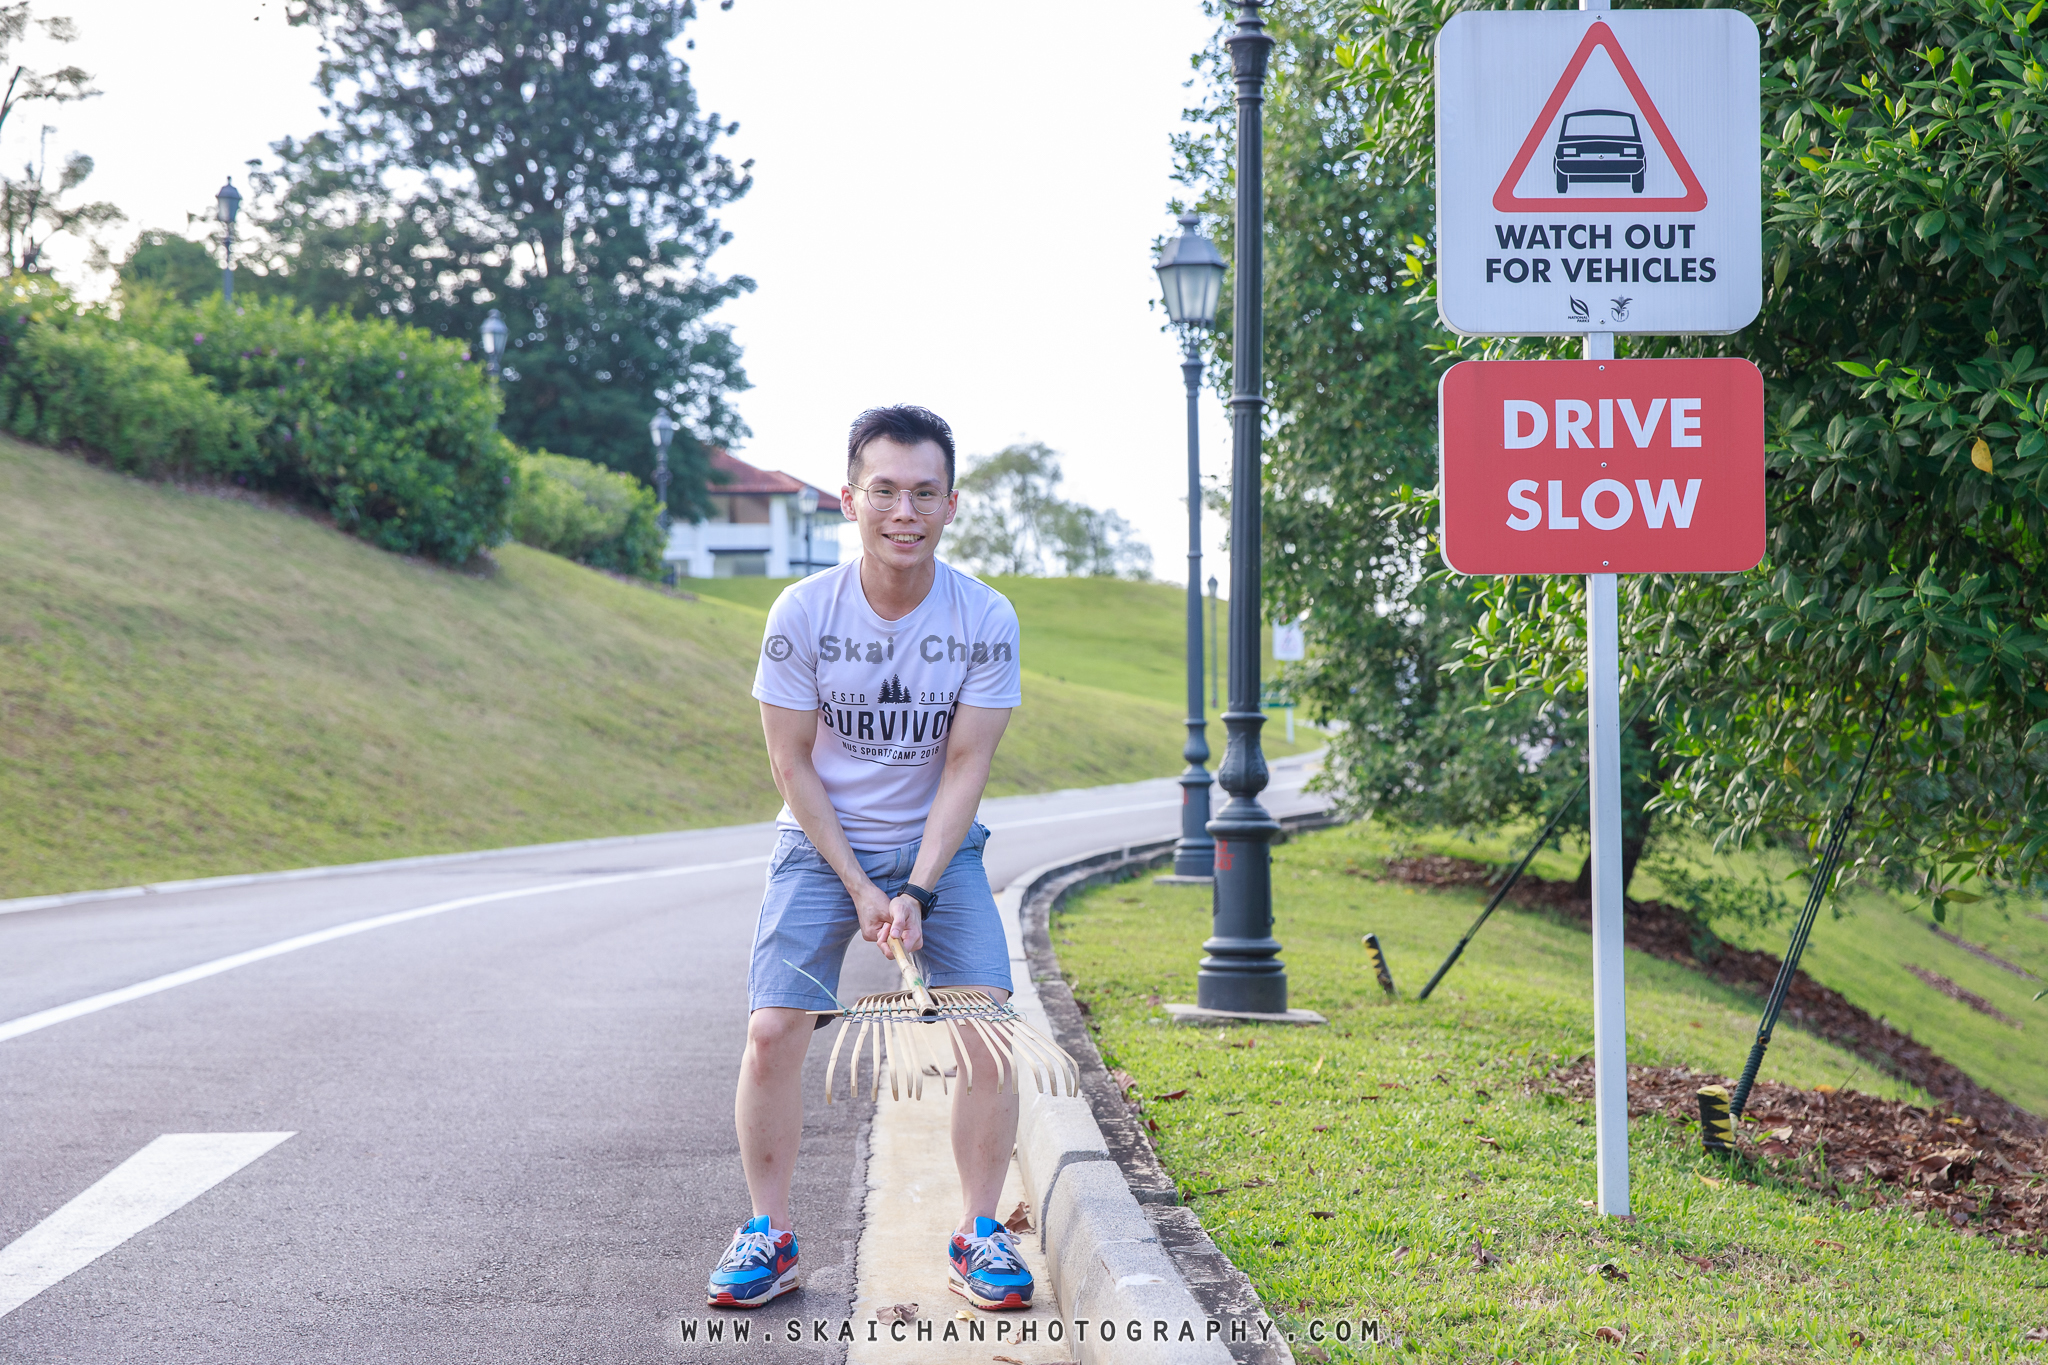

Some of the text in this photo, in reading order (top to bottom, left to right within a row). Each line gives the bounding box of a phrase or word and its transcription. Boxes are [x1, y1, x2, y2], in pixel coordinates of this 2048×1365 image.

[1494, 223, 1696, 249] WATCH OUT
[1485, 256, 1717, 283] FOR VEHICLES
[1503, 398, 1702, 449] DRIVE
[1505, 478, 1702, 531] SLOW
[831, 691, 955, 703] ESTD 2018
[842, 741, 858, 753] NUS
[920, 745, 940, 759] 2018
